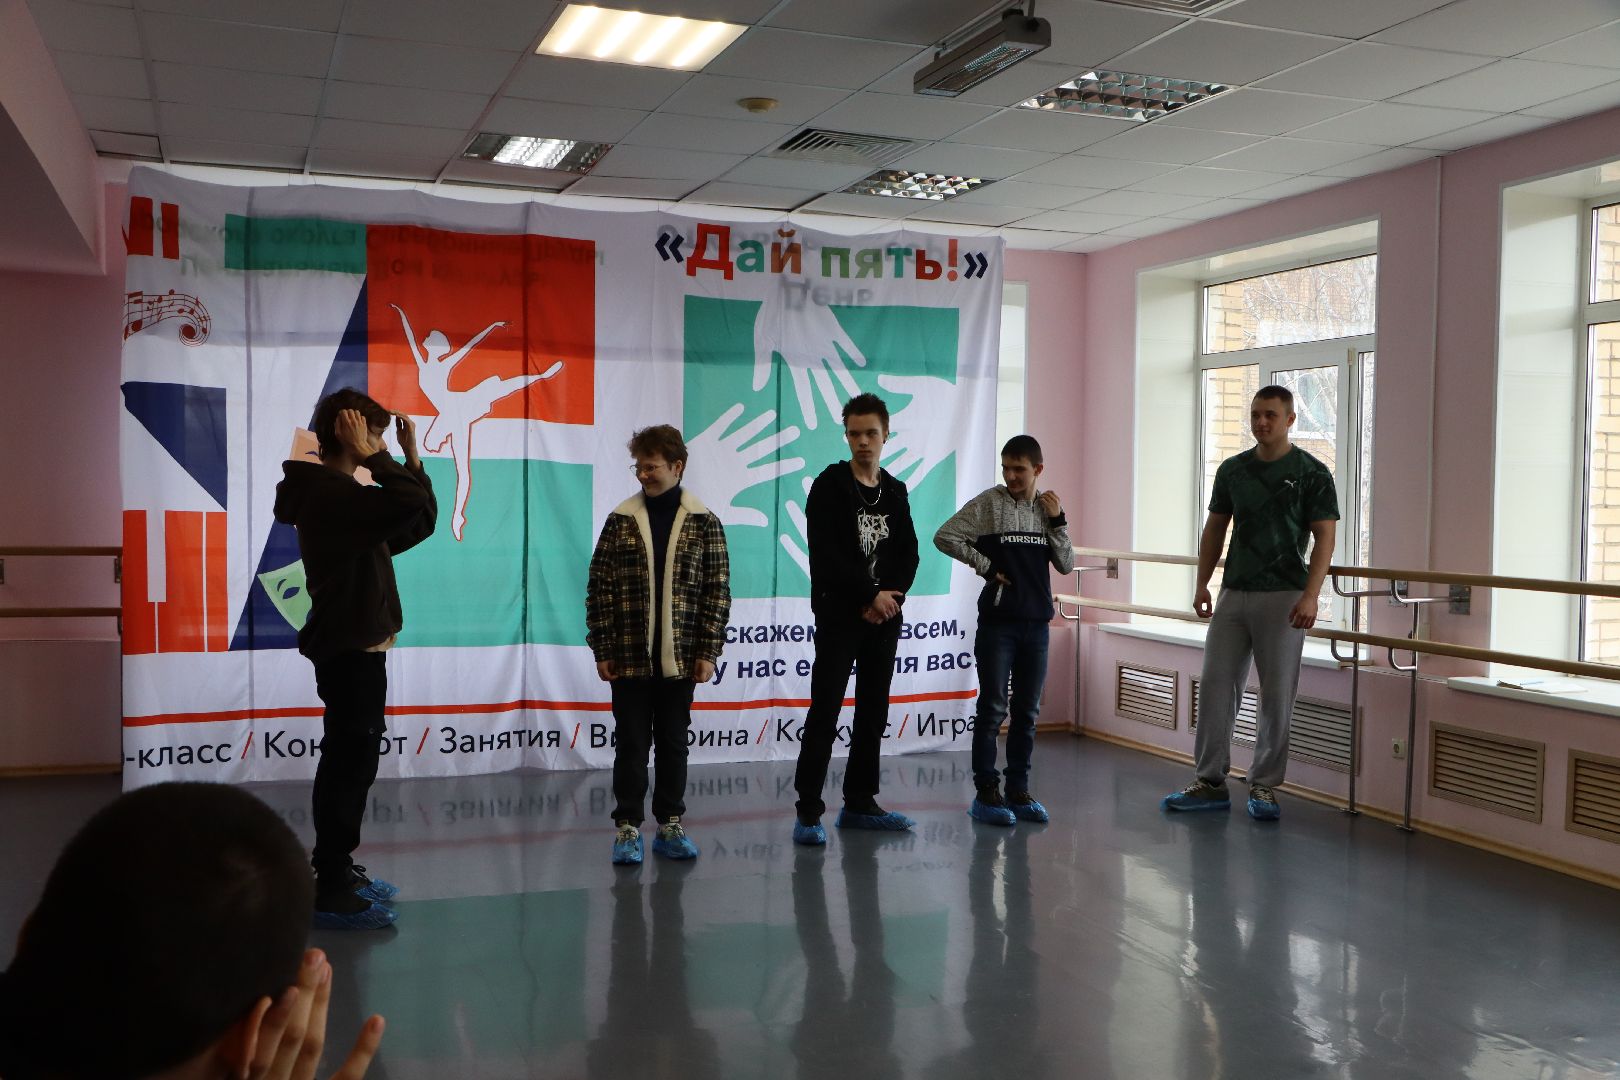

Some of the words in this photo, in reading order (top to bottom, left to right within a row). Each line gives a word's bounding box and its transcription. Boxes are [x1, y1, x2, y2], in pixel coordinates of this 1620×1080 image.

[655, 222, 802, 280] «Дай
[821, 238, 988, 281] пять!»
[1000, 535, 1049, 546] PORSCHE
[737, 658, 787, 679] нас
[439, 726, 561, 754] Занятия
